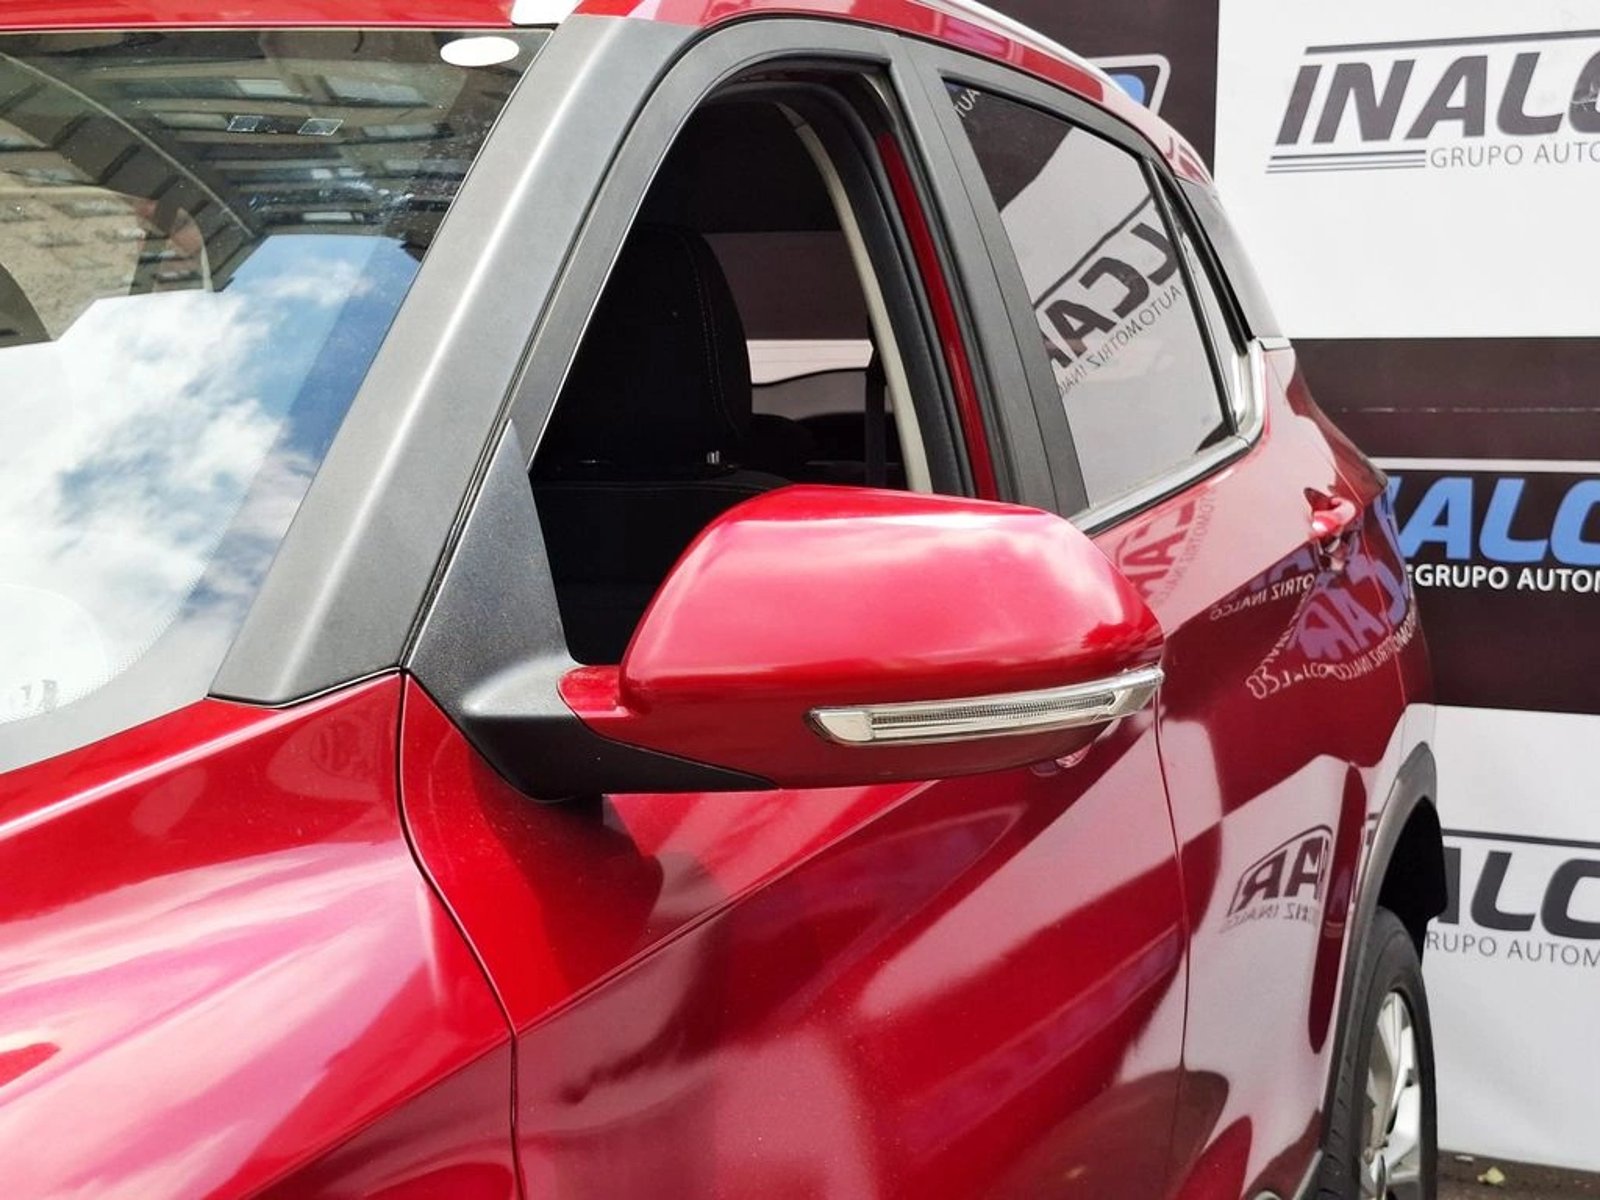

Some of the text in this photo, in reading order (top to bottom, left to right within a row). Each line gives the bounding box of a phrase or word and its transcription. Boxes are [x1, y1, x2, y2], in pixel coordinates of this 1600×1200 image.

[1430, 144, 1524, 169] GRUPO
[1414, 564, 1600, 593] GRUPO AUTO
